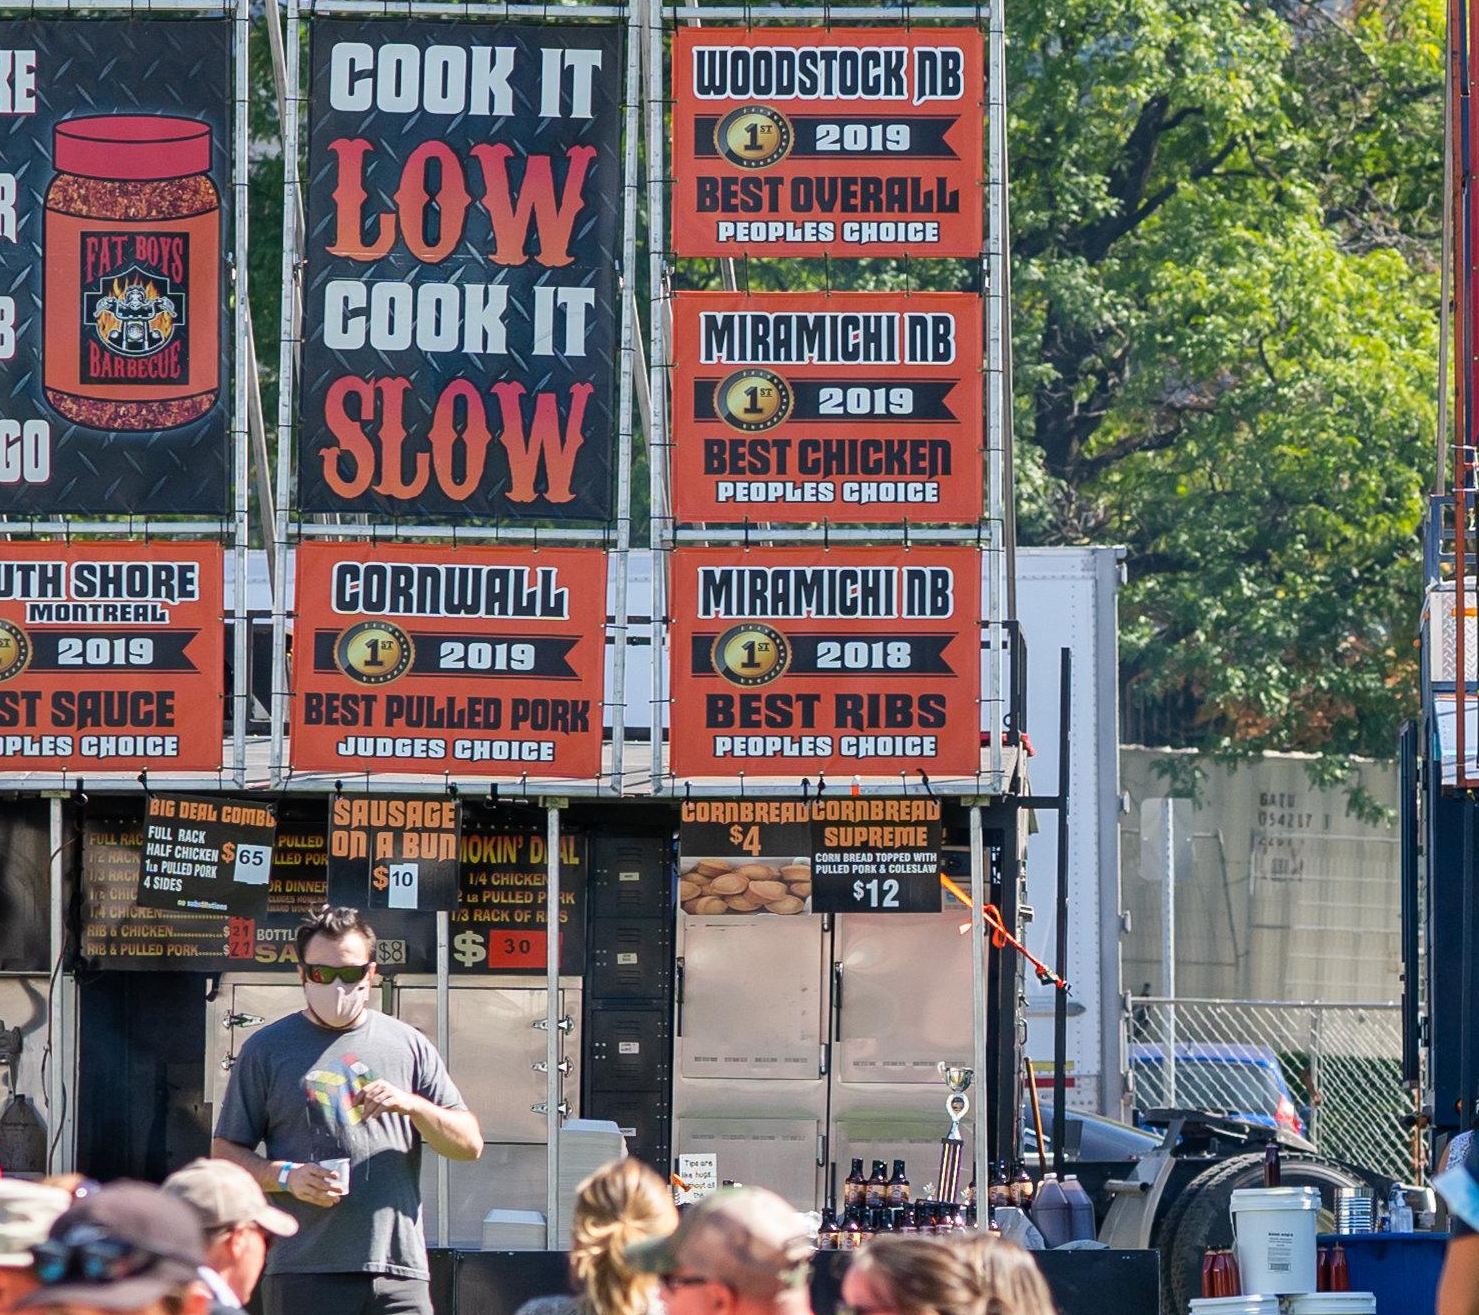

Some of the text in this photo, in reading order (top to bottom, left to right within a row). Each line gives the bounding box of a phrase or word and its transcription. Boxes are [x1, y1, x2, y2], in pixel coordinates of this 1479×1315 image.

[330, 42, 603, 118] COOK IT
[328, 138, 598, 267] LOW
[324, 282, 596, 356] COOK IT
[320, 375, 595, 503] SLOW
[697, 566, 953, 620] MIRAMICHI NB
[816, 643, 912, 669] 2018
[705, 693, 946, 733] BEST RIBS
[714, 735, 937, 761] PEOPLES CHOICE
[149, 800, 175, 817] BIG
[180, 803, 218, 821] DEAL
[333, 799, 455, 829] SAUSAGE
[682, 802, 810, 824] CORNBREAD
[812, 800, 941, 822] CORNBREAD
[149, 826, 205, 844] FULL RACK
[332, 831, 457, 860] ON A BUN
[729, 825, 761, 856] $4
[825, 827, 928, 848] SUPREME
[815, 852, 937, 863] CORN BREAD TOPPED WITH
[815, 864, 936, 874] PULLED PORK & COLESLAW
[143, 878, 183, 892] 4 SIDES
[853, 879, 900, 907] $12
